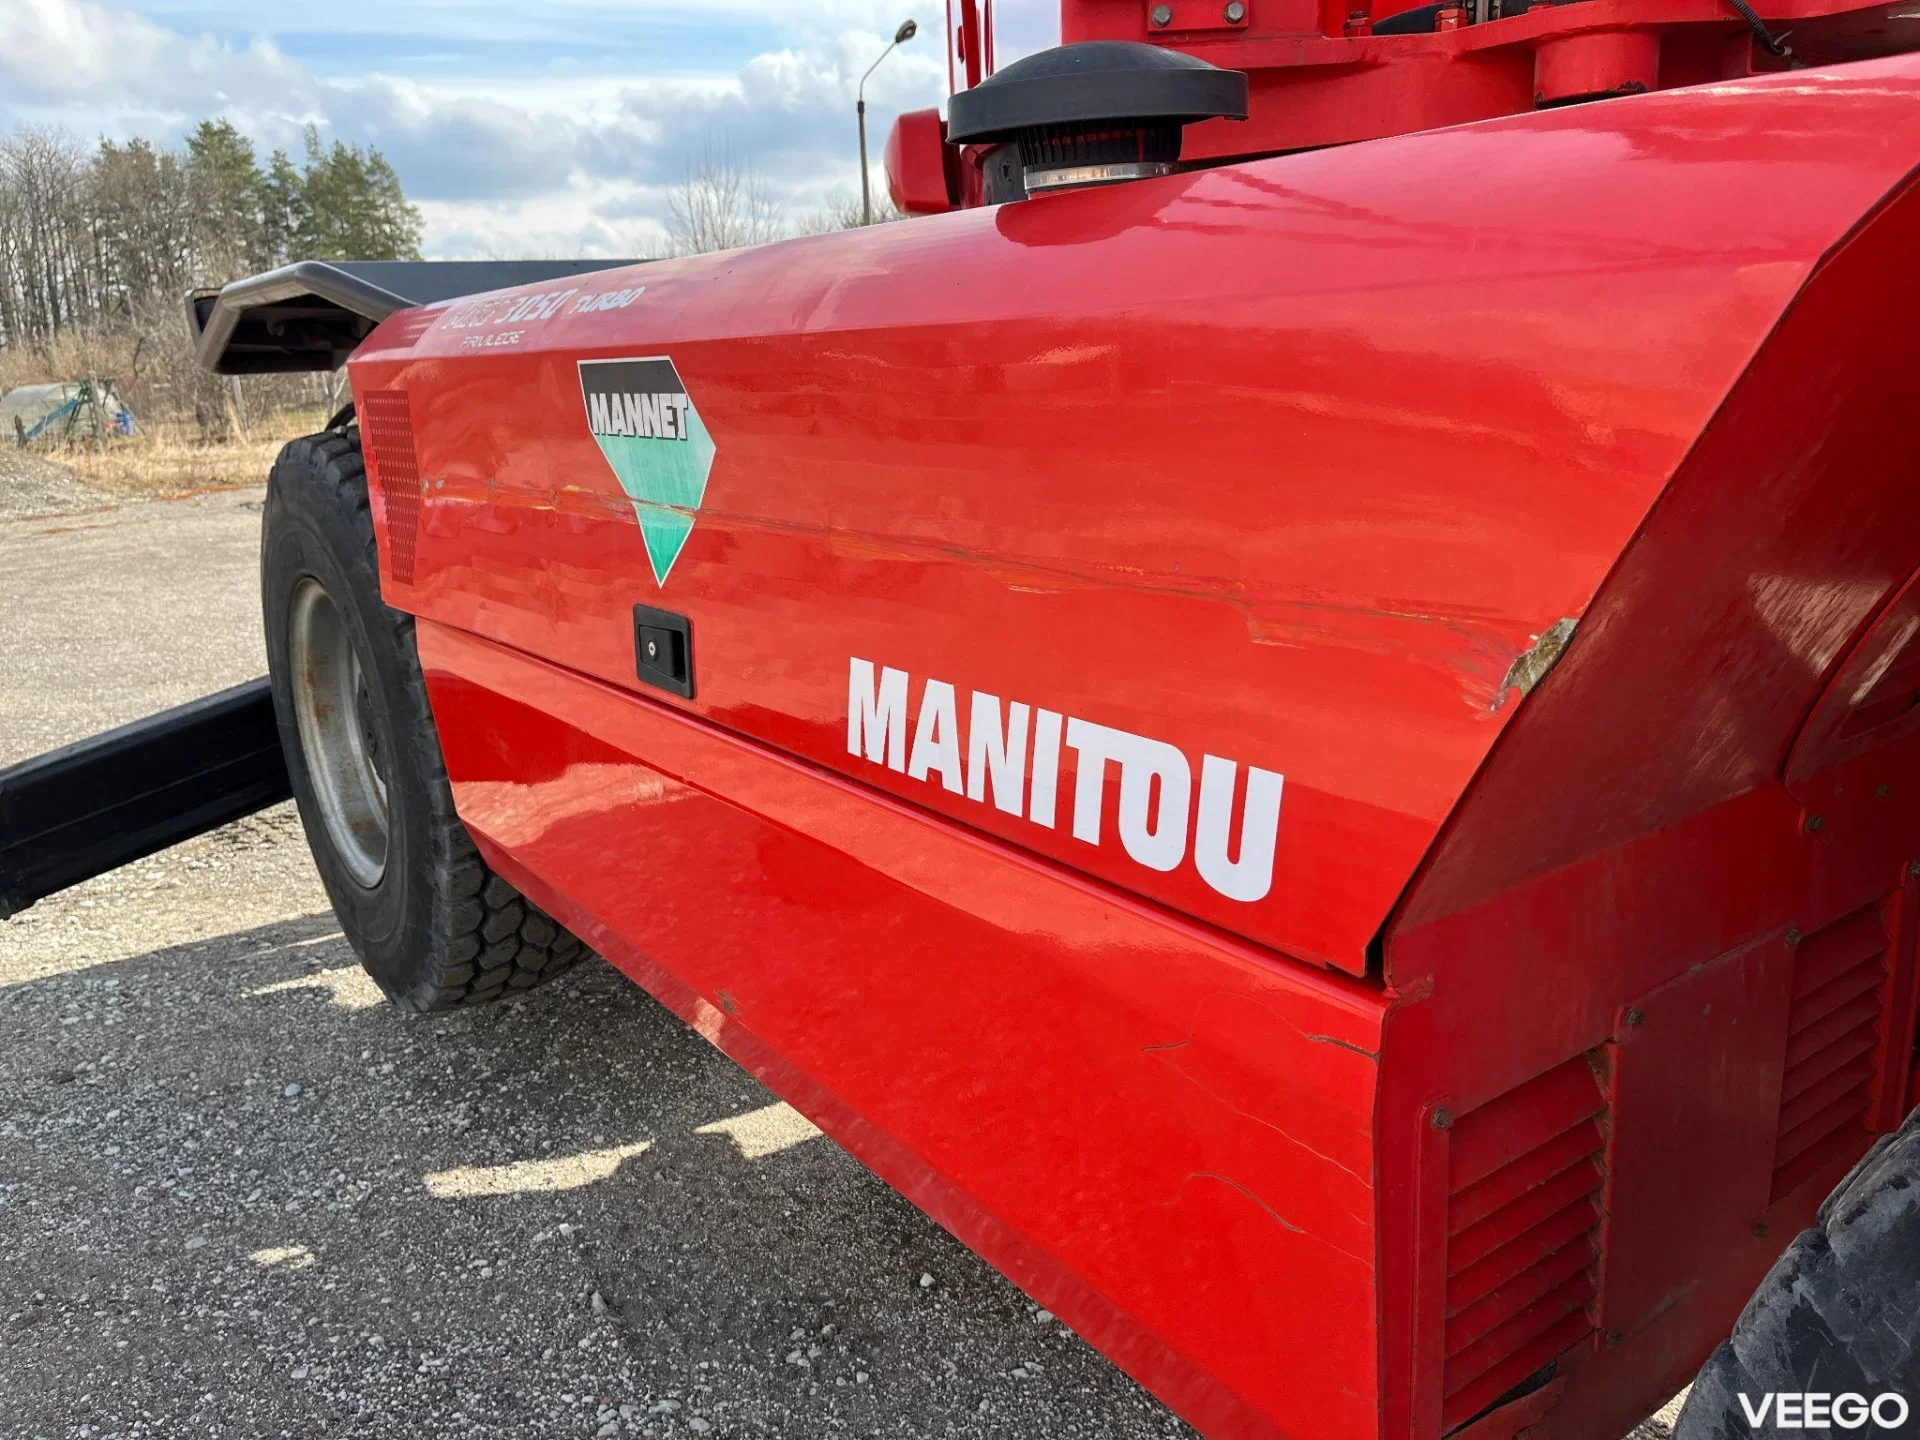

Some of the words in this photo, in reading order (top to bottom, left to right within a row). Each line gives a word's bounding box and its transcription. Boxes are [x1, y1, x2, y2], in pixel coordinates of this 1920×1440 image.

[493, 288, 579, 325] 3050
[568, 285, 646, 315] TURBO
[589, 392, 689, 441] MANNET
[847, 656, 1285, 903] MANITOU
